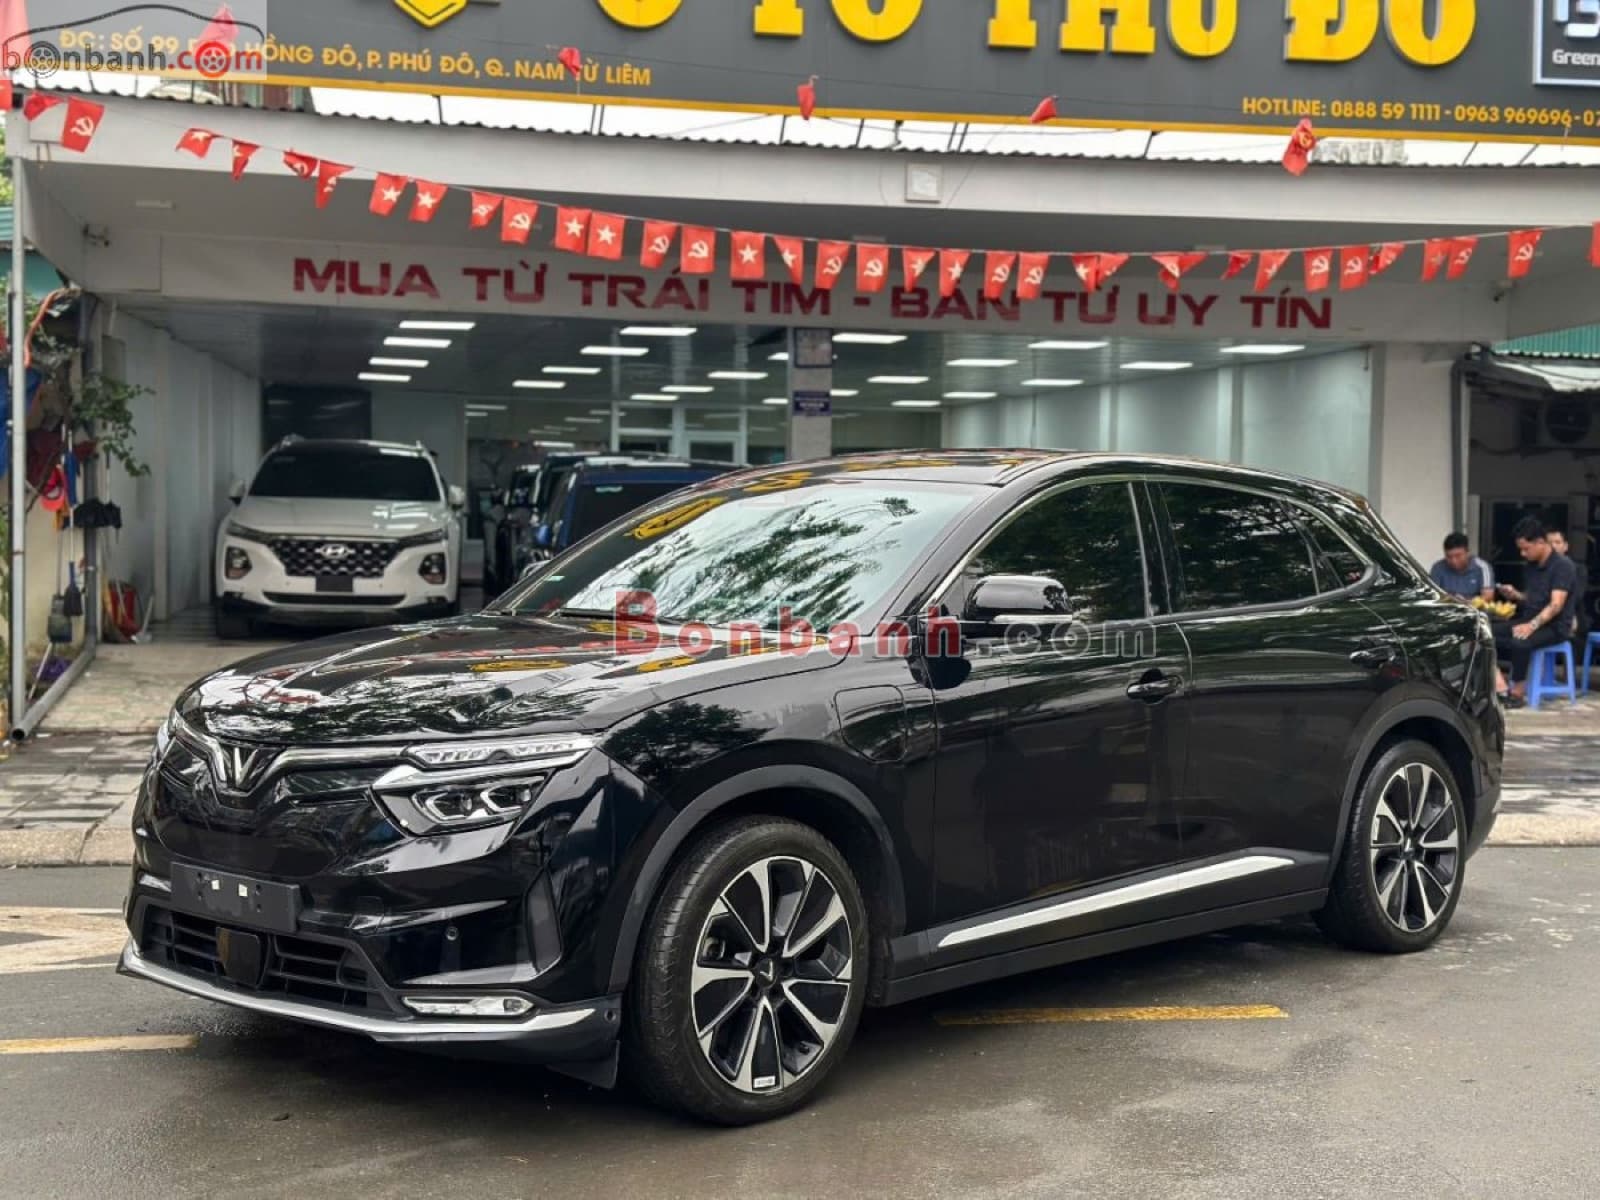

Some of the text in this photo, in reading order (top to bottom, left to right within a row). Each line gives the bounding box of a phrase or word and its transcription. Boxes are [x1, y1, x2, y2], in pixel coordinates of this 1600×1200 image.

[111, 26, 143, 50] SỐ
[151, 36, 179, 53] 99
[322, 45, 362, 69] ĐÔ,
[367, 51, 382, 68] P.
[388, 49, 432, 72] PHÚ
[439, 54, 480, 78] ĐÔ,
[486, 59, 510, 77] Q.
[515, 60, 565, 80] NAM
[606, 61, 652, 86] LIÊM
[1243, 97, 1326, 117] HOTLINE:
[1331, 100, 1377, 118] 0888
[1383, 102, 1404, 119] 59
[1410, 103, 1440, 121] 1111
[1455, 105, 1499, 123] 0963
[1504, 107, 1572, 126] 969696
[293, 258, 440, 298] MUA
[463, 261, 547, 303] TỪ
[568, 266, 710, 312] TRÁI
[731, 280, 831, 315] TIM
[1240, 288, 1332, 329] TÍN
